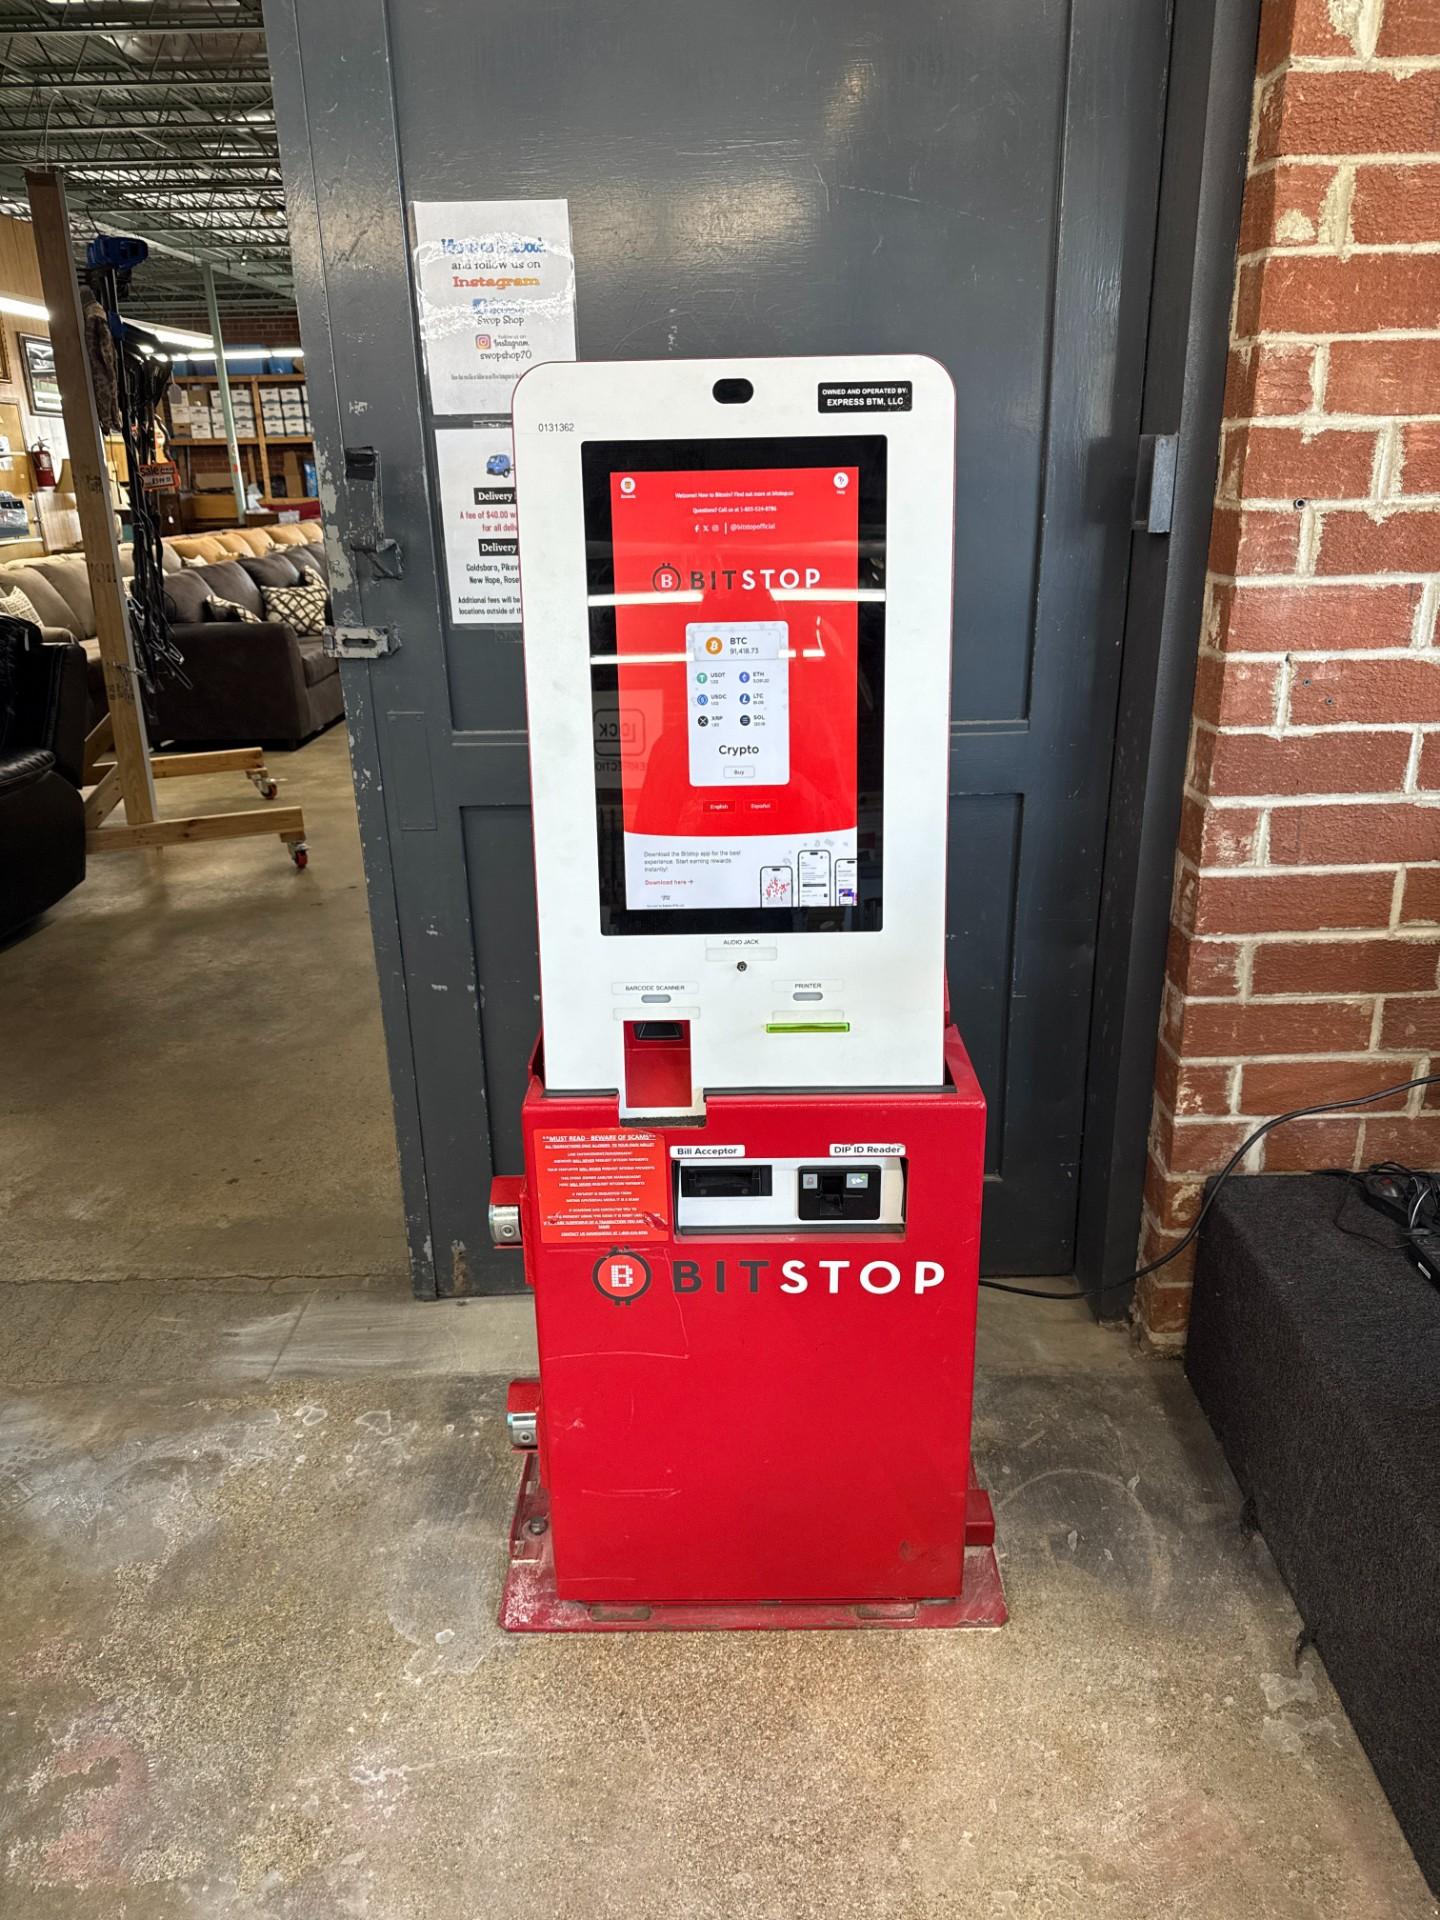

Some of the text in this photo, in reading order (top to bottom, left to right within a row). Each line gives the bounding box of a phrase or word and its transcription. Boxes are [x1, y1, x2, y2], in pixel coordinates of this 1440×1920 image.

[511, 260, 524, 269] us
[527, 260, 540, 269] on
[453, 276, 540, 289] Instagram
[477, 315, 525, 326] Swop Shop
[494, 339, 530, 348] Instagram
[480, 350, 532, 361] swopshop70
[827, 397, 904, 406] EXPRESS BTM, LLC
[538, 424, 574, 433] 0131362
[478, 492, 513, 503] Delivery
[460, 511, 464, 520] A
[466, 511, 476, 520] fee
[478, 511, 484, 520] of
[486, 511, 508, 520] $40.00
[482, 522, 492, 532] for
[494, 522, 502, 532] all
[731, 523, 776, 532] @bitstopofficial
[481, 543, 517, 554] Delivery
[466, 563, 500, 573] Goldsboro,
[469, 576, 483, 585] New
[485, 576, 502, 585] Hope,
[690, 568, 821, 591] BITSTOP
[458, 596, 486, 604] Additional
[488, 596, 500, 604] fees
[502, 596, 514, 604] will
[459, 607, 485, 615] locations
[487, 607, 505, 615] outside
[508, 607, 515, 615] of
[730, 637, 748, 645] BTC
[719, 745, 760, 757] Crypto
[710, 803, 729, 811] English
[677, 1146, 738, 1157] Bill Acceptor
[834, 1146, 850, 1154] DIP
[867, 1145, 900, 1153] Reader
[672, 1260, 945, 1295] BITSTOP
